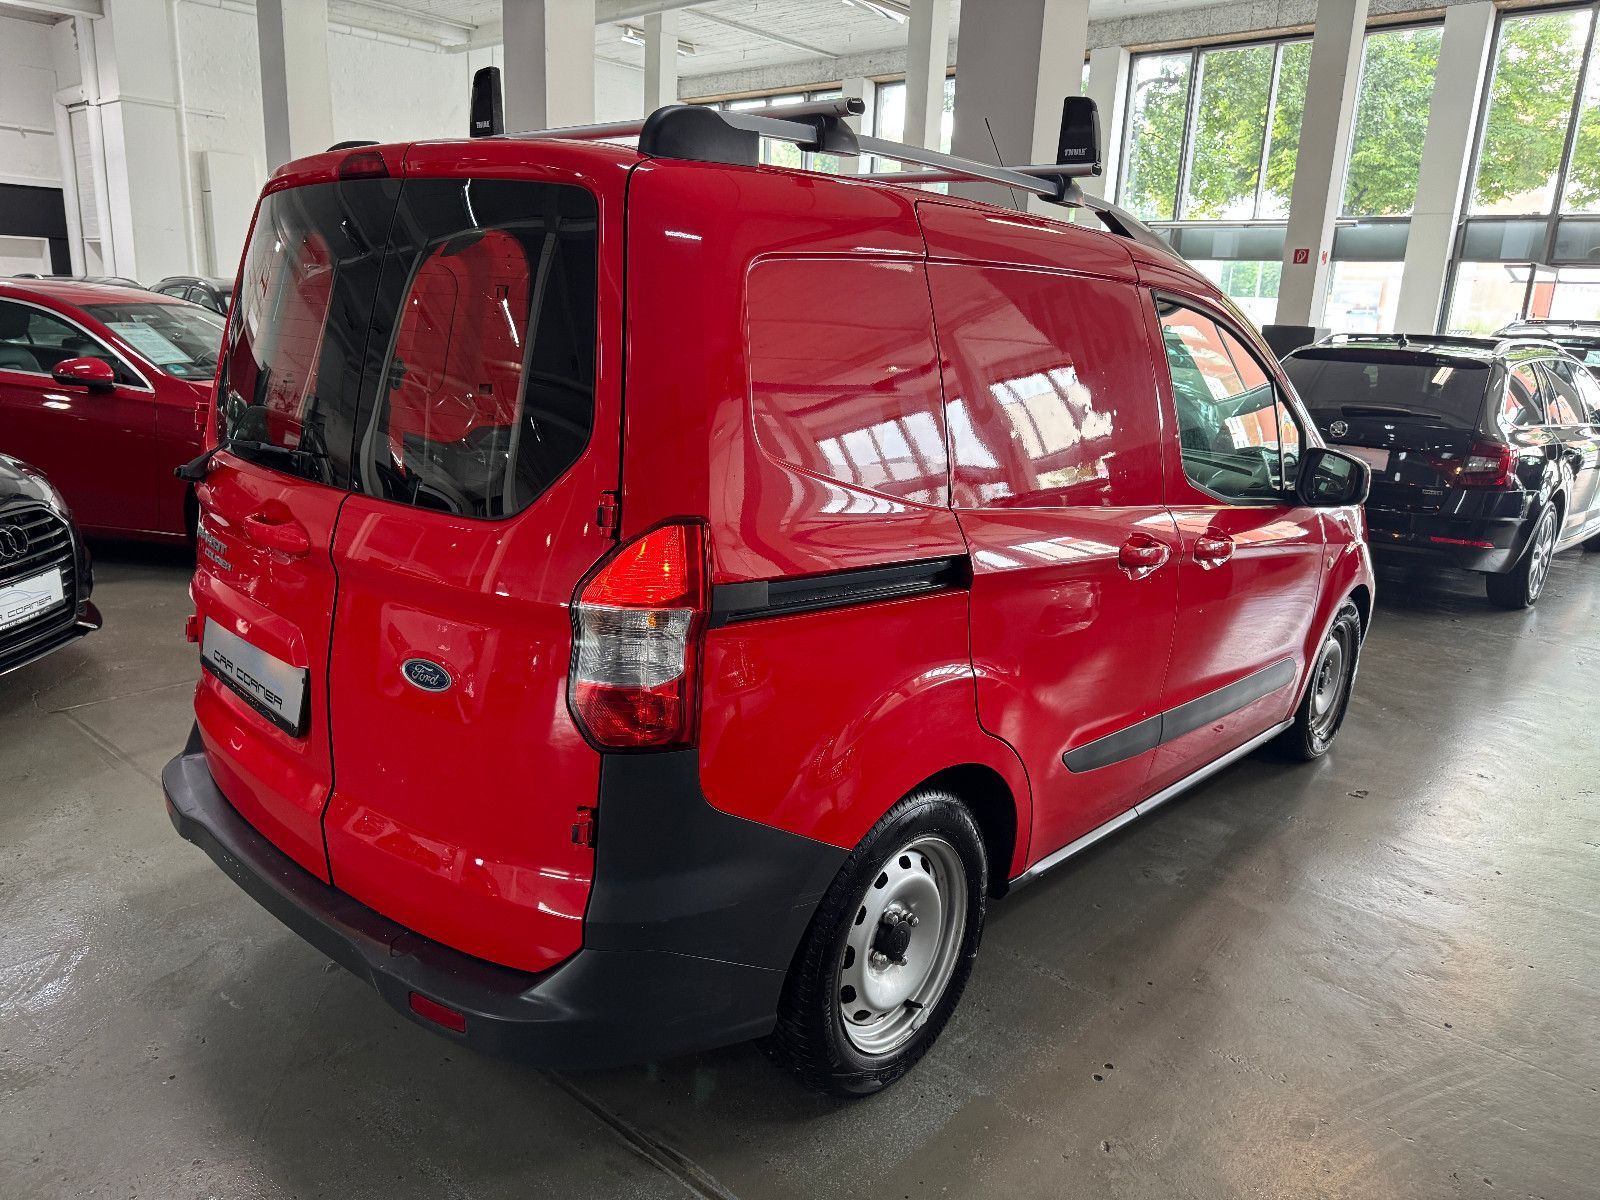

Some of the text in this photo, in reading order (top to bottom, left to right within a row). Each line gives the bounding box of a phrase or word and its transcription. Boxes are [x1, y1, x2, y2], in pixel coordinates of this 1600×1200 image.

[213, 649, 283, 710] CAR CORNER
[411, 664, 440, 686] Ford
